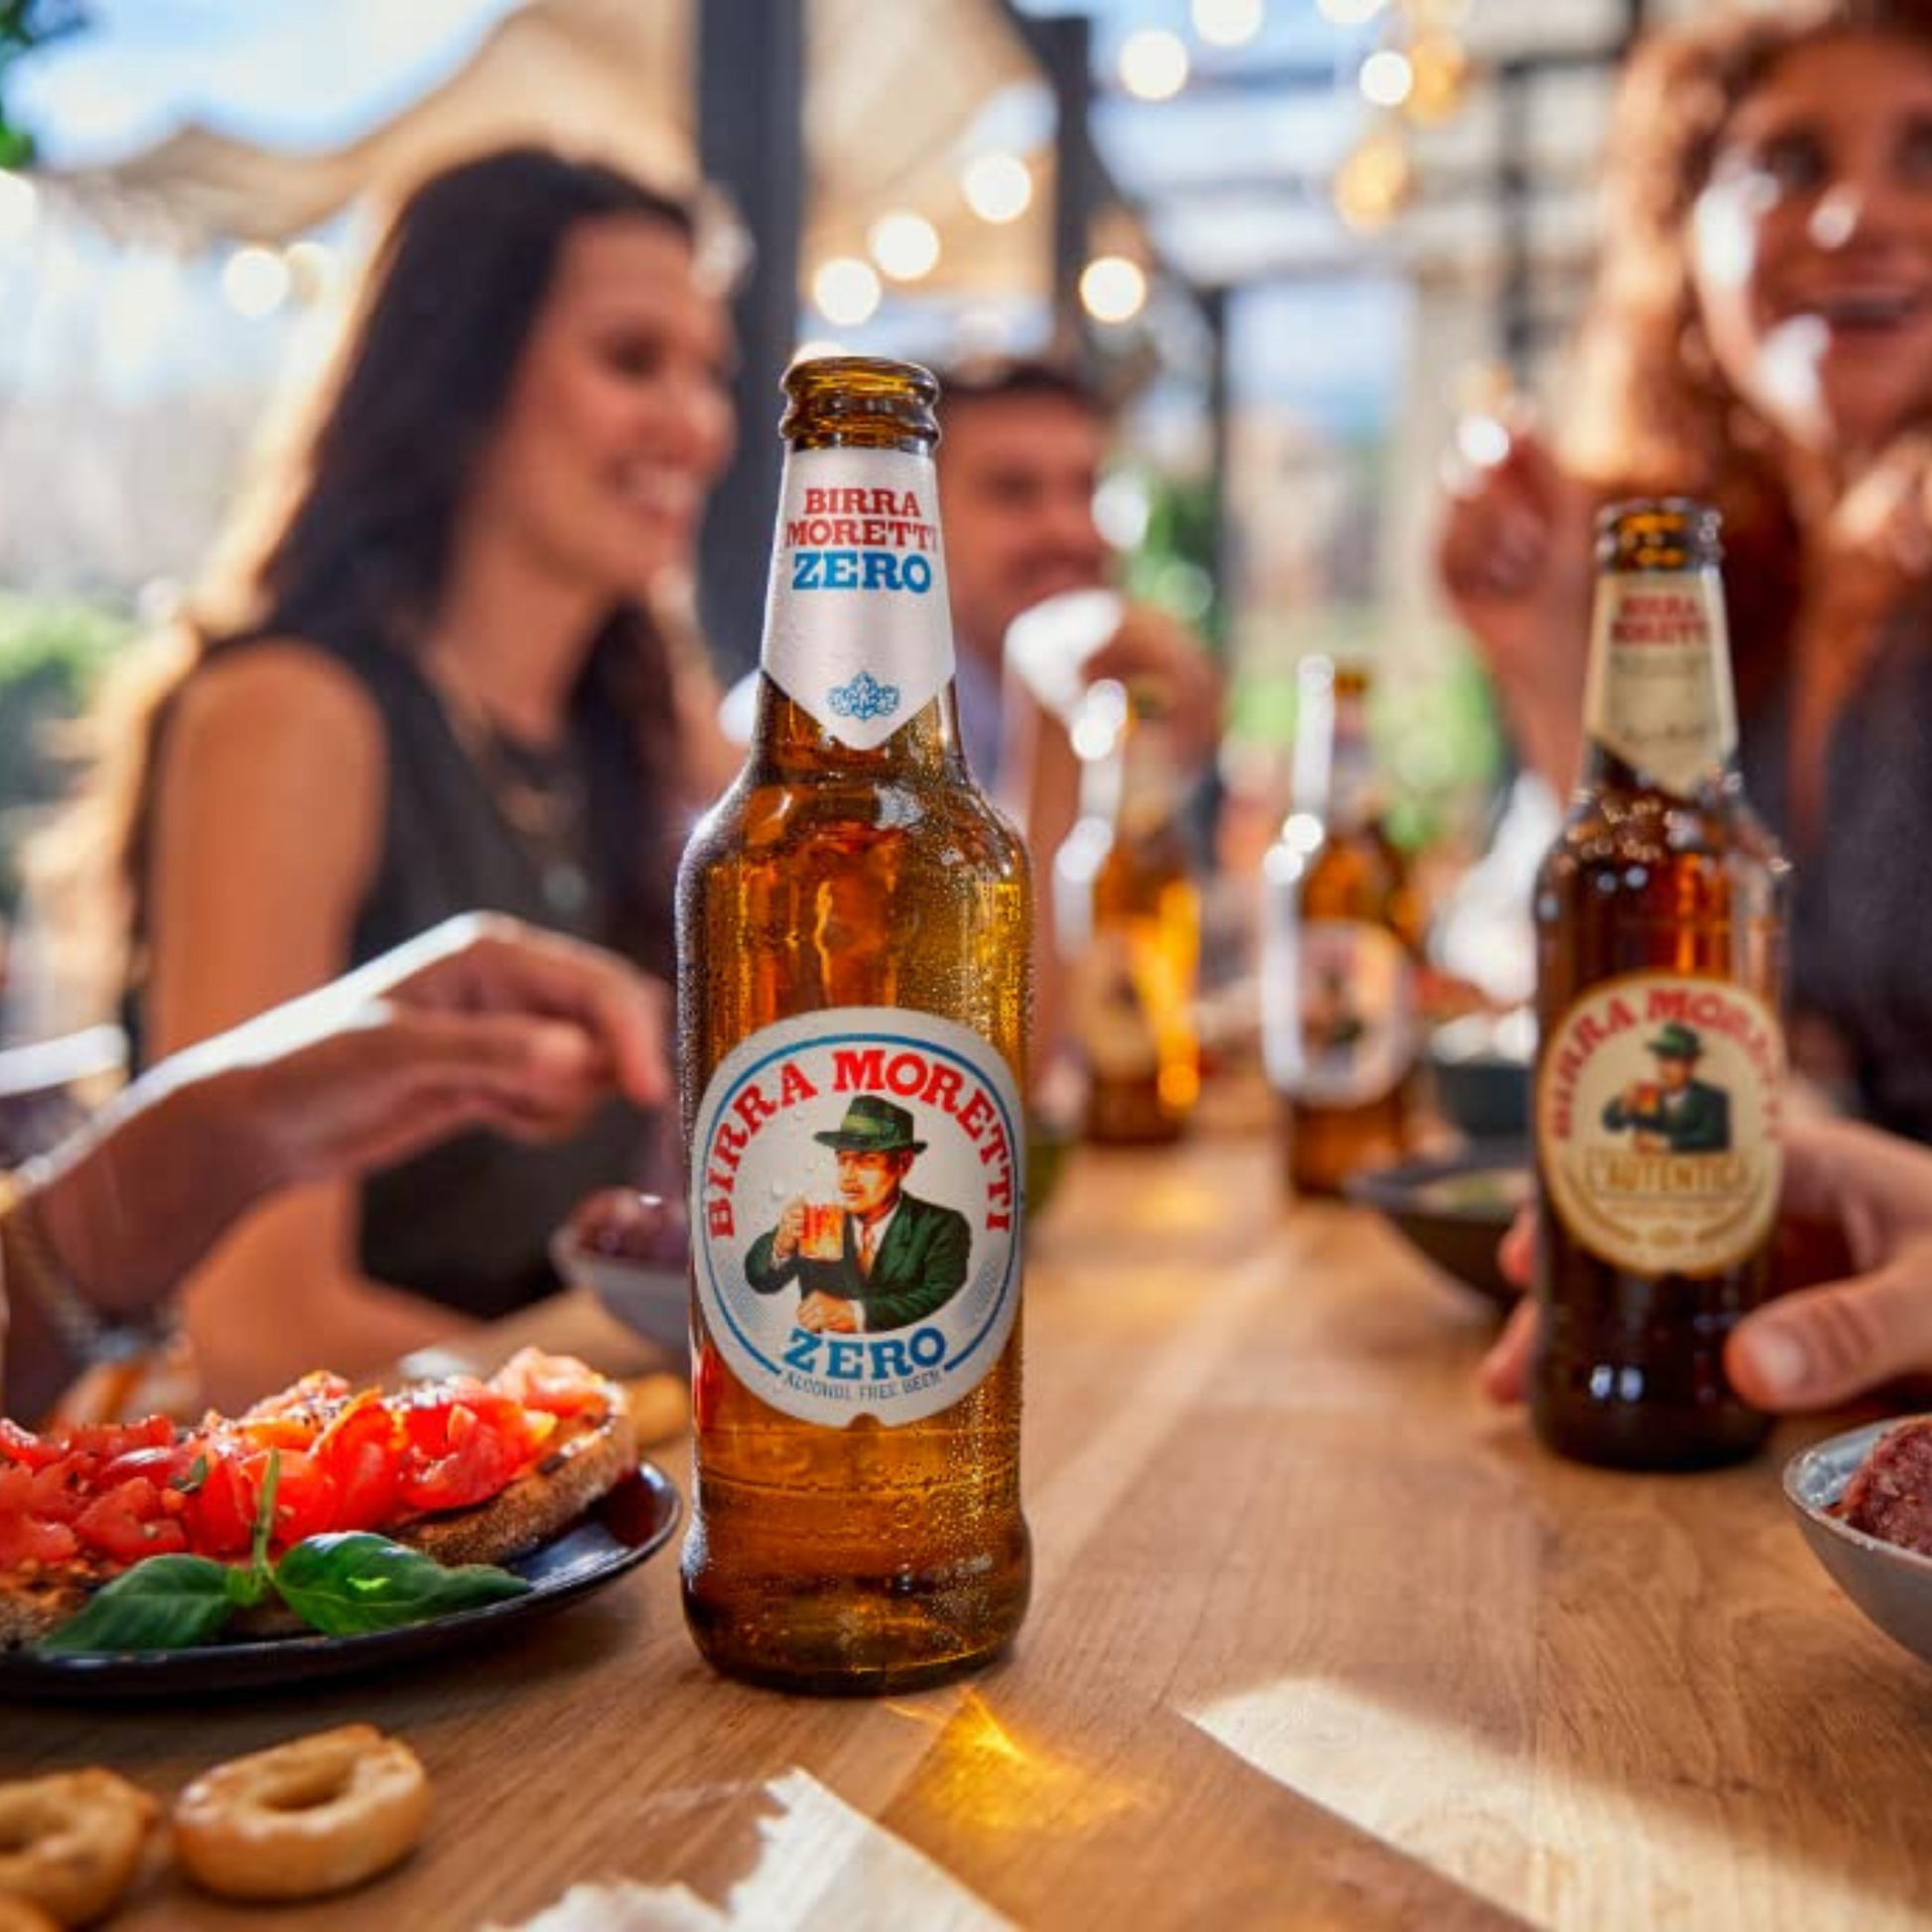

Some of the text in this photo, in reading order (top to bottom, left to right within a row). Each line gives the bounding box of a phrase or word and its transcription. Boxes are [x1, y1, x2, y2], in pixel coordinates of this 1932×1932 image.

[804, 487, 921, 517] BIRRA
[792, 551, 931, 594] ZERO
[707, 1049, 1012, 1240] BIRRA MORETTI
[782, 1326, 946, 1382] ZERO
[859, 1381, 897, 1401] FREE
[901, 1369, 942, 1394] BEER
